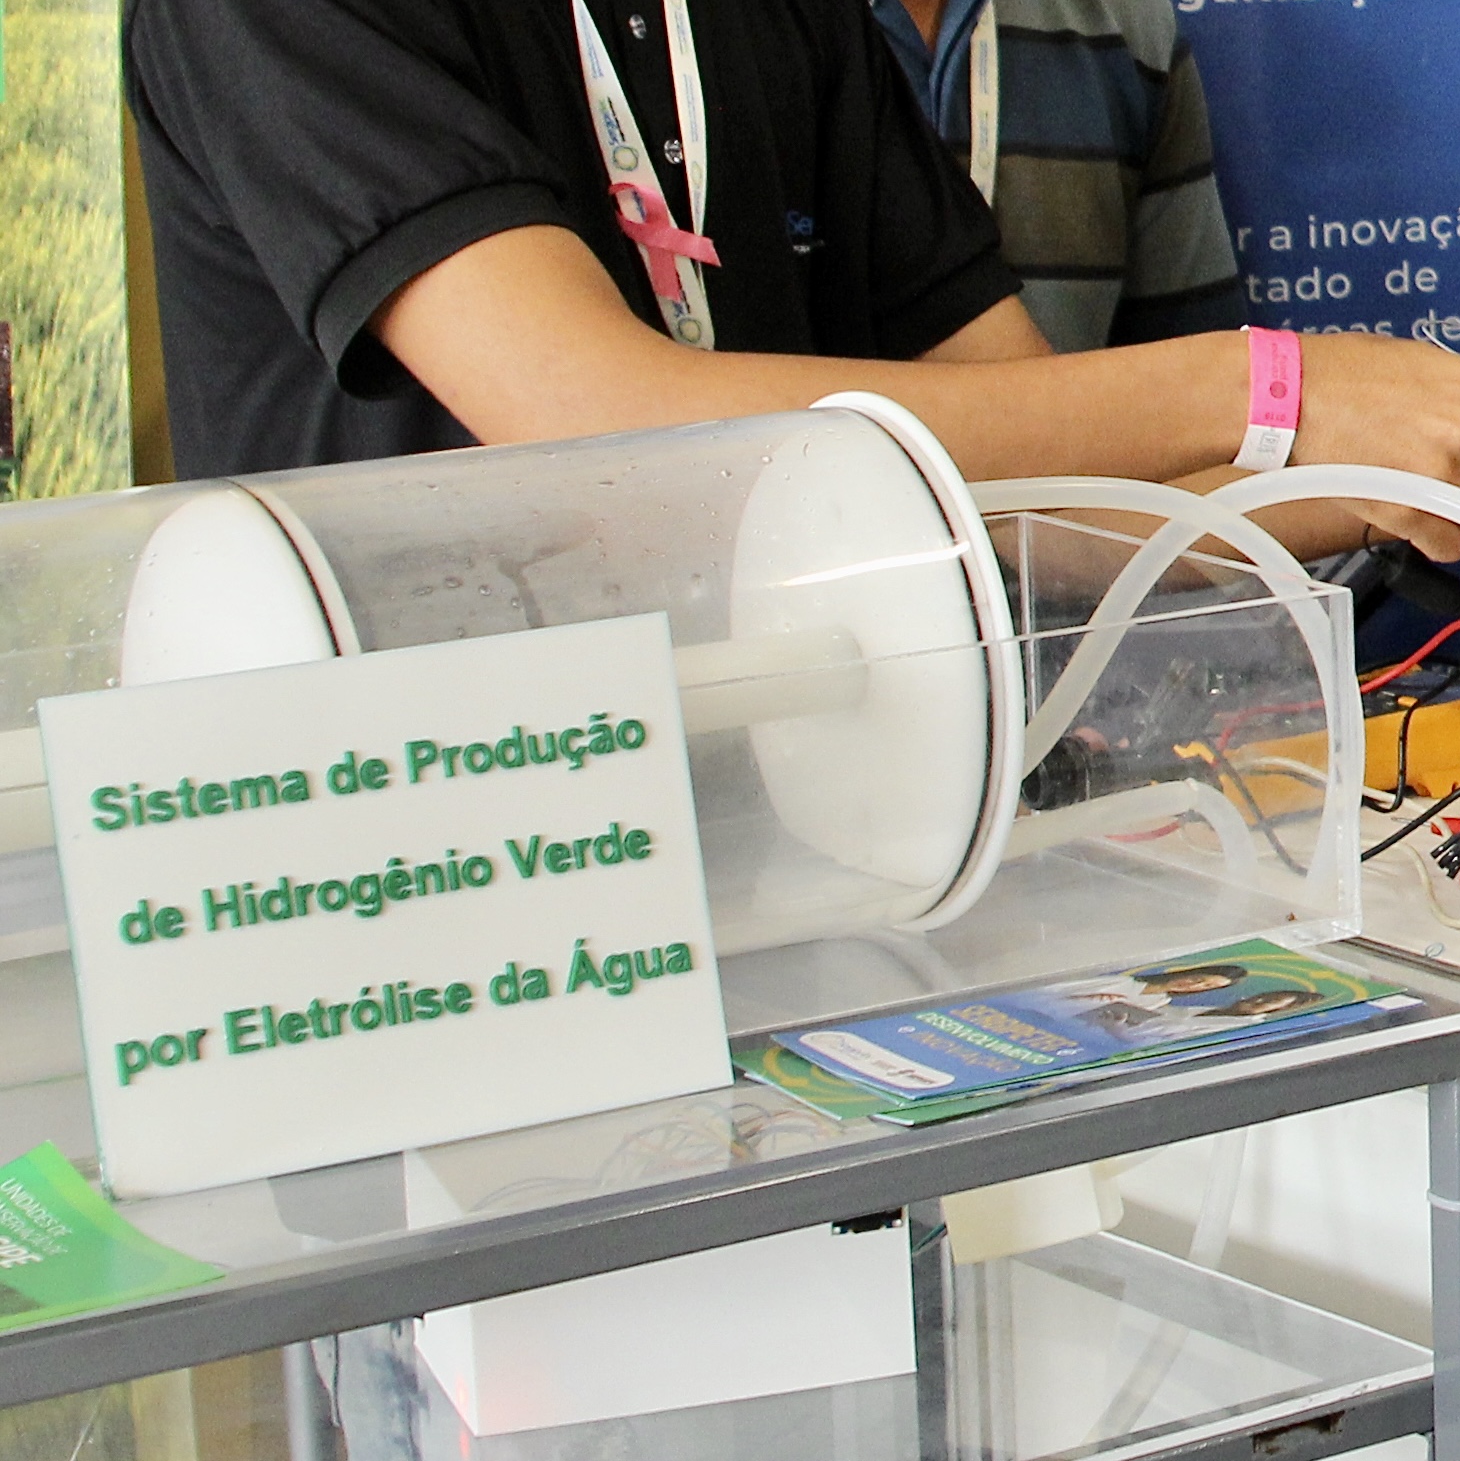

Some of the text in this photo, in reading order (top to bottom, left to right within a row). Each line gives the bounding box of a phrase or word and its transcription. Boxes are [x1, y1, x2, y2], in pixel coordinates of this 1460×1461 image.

[1269, 224, 1293, 251] a
[1384, 260, 1438, 296] de
[90, 711, 644, 832] Sistema de Produção
[118, 823, 650, 945] de Hidrogênio Verde
[114, 938, 691, 1087] por Eletrólise da Água
